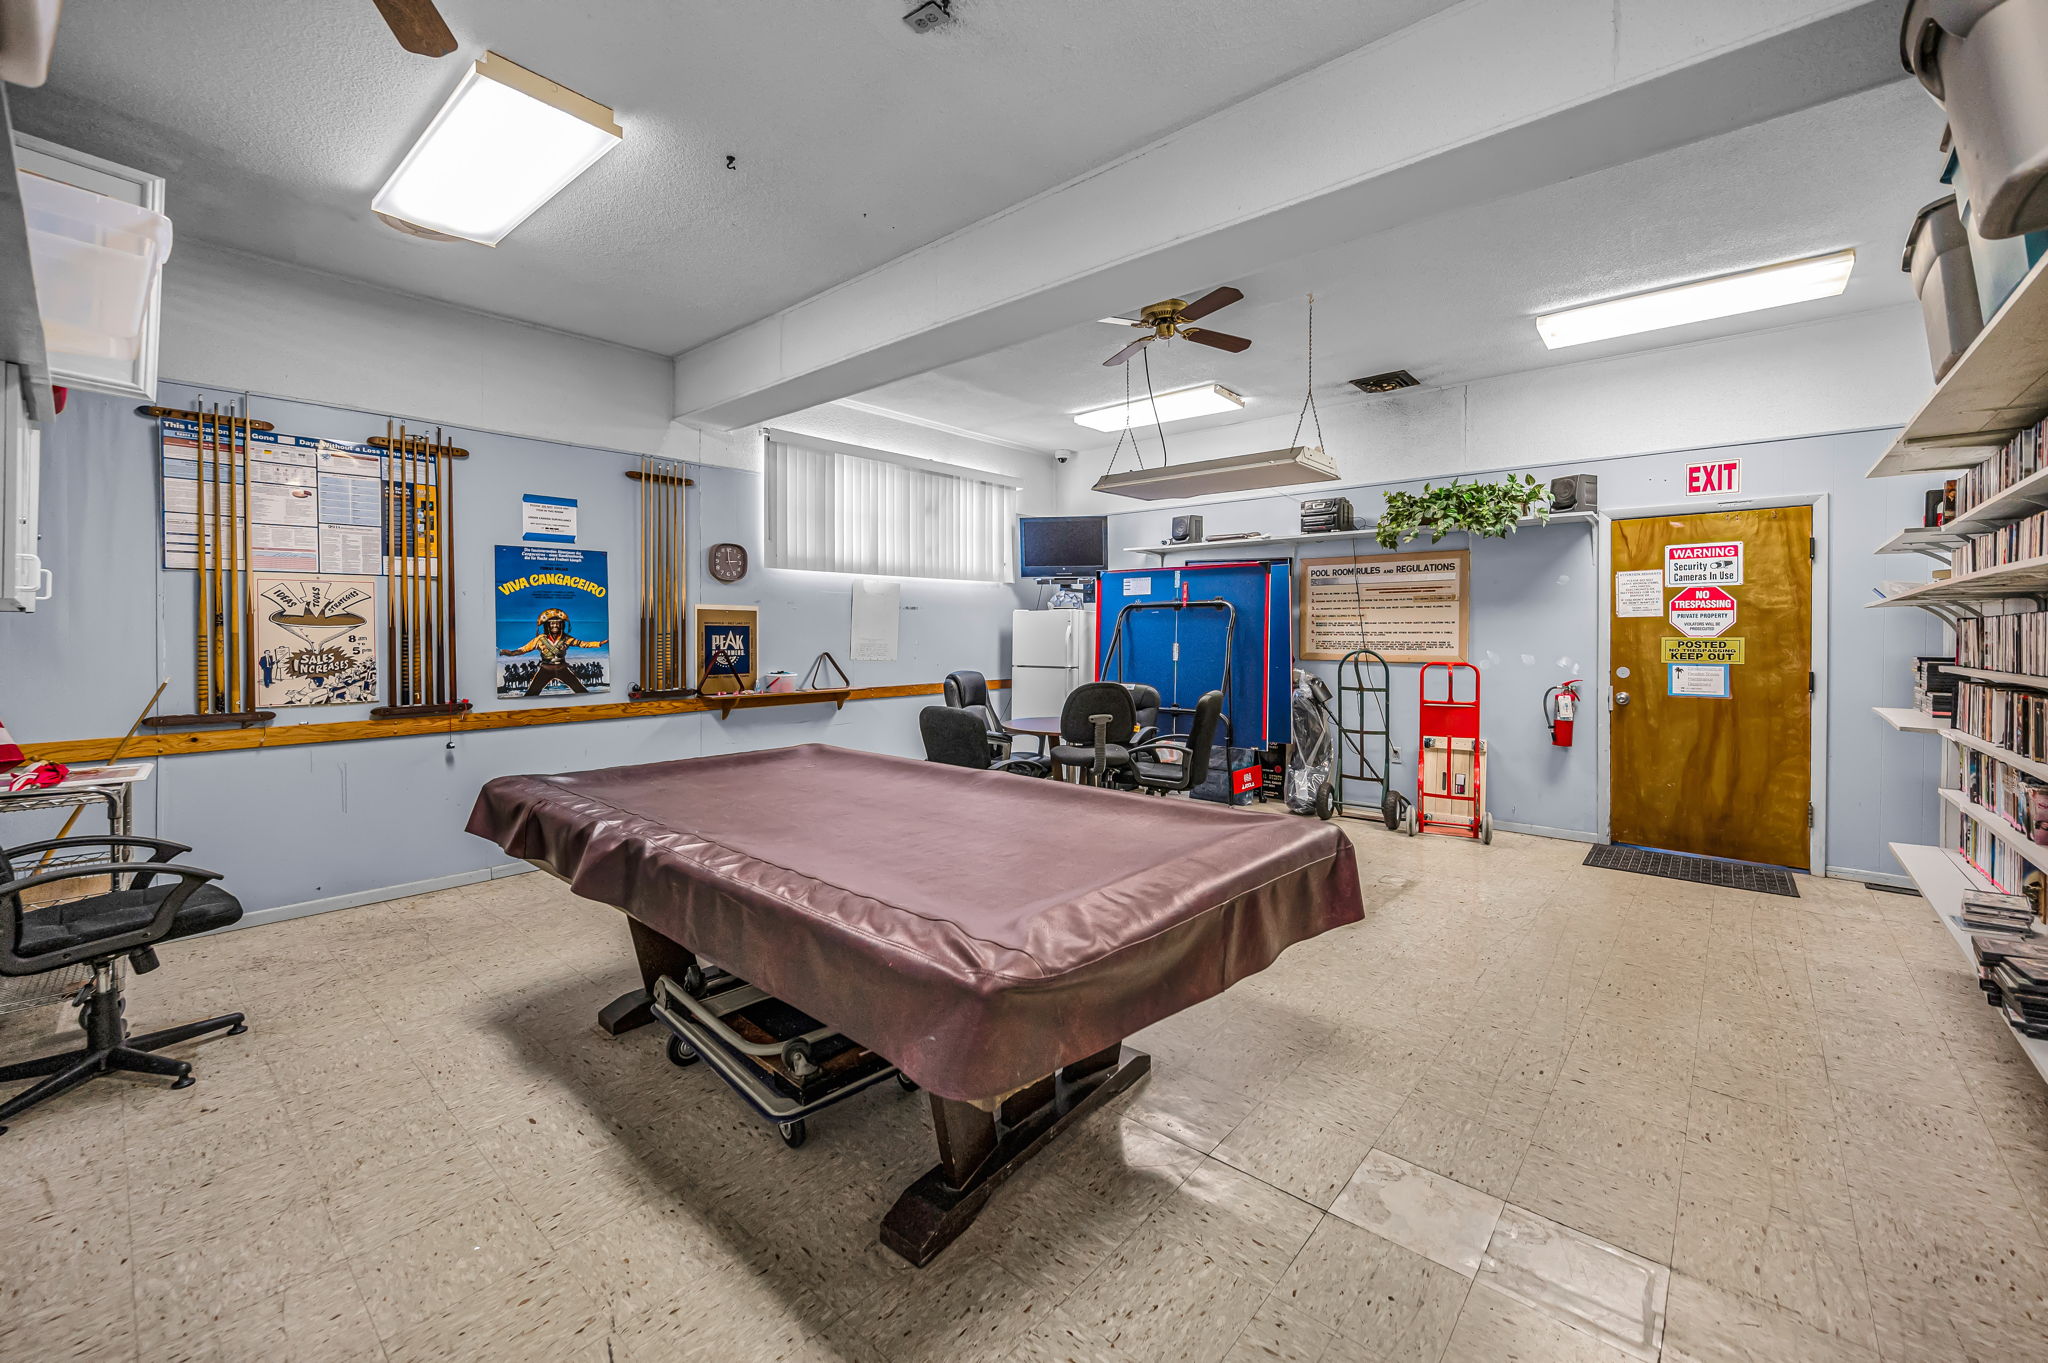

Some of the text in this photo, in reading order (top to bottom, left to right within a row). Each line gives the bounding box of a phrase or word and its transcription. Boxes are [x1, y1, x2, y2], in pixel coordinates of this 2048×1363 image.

[163, 420, 185, 430] This
[251, 432, 275, 441] Gone
[321, 441, 353, 451] Without
[362, 446, 381, 455] Loss
[1688, 462, 1738, 493] EXIT
[1672, 546, 1735, 559] WARNING
[1310, 568, 1330, 578] POOL
[1332, 568, 1354, 576] ROOM
[1356, 566, 1381, 575] RULES
[1396, 562, 1456, 574] REGULATIONS
[1673, 561, 1708, 572] Security
[1673, 571, 1734, 582] Cameras In Use
[498, 577, 530, 596] VIVA
[529, 573, 607, 598] CANGACEIRO
[273, 589, 298, 608] IDEAS
[311, 586, 321, 608] TOOLS
[1695, 590, 1710, 599] NO
[327, 590, 359, 614] STRATEGIES
[1674, 599, 1732, 609] TRESPASSING
[348, 635, 357, 643] 8
[711, 629, 745, 650] PEAK
[1677, 640, 1727, 649] POSTED
[352, 646, 361, 655] 5
[1707, 652, 1735, 661] OUT
[300, 653, 335, 665] SALES
[293, 659, 349, 674] INCREASES
